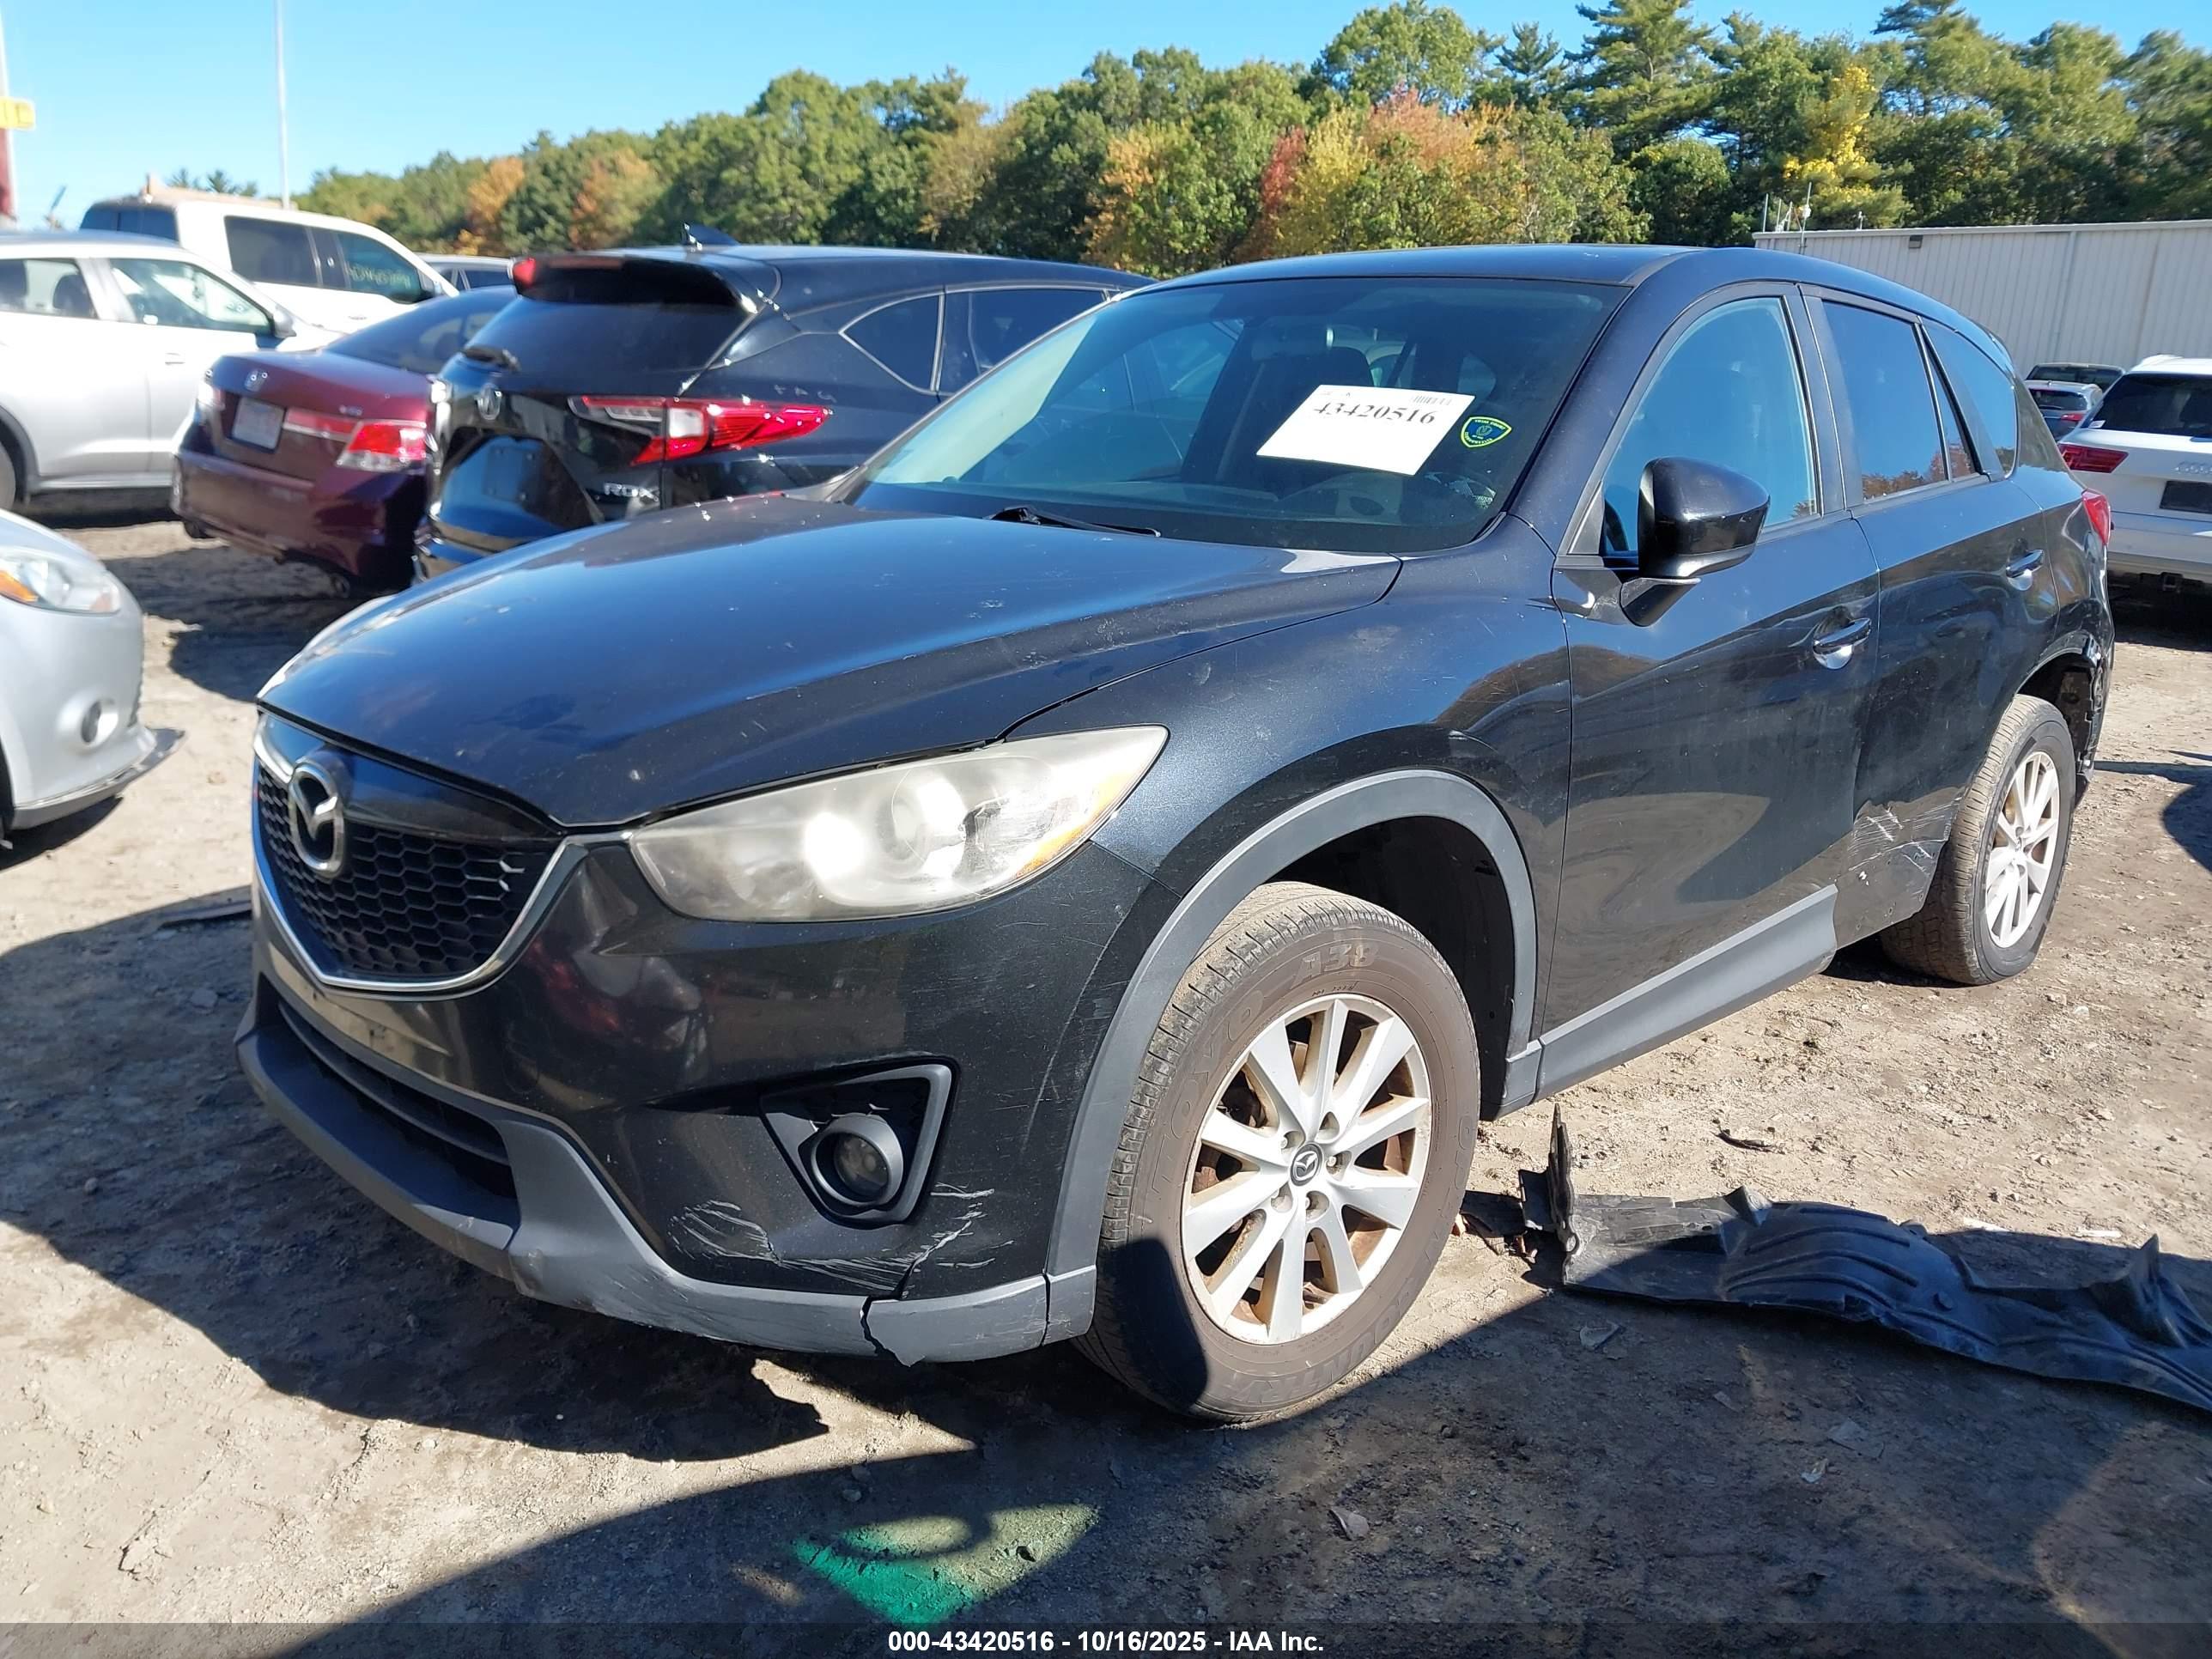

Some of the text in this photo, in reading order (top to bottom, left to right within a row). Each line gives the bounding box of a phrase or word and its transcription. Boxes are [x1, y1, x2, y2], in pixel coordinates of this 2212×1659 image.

[1313, 401, 1438, 424] 43420516
[604, 482, 660, 502] RDX
[1151, 989, 1265, 1194] TOYO
